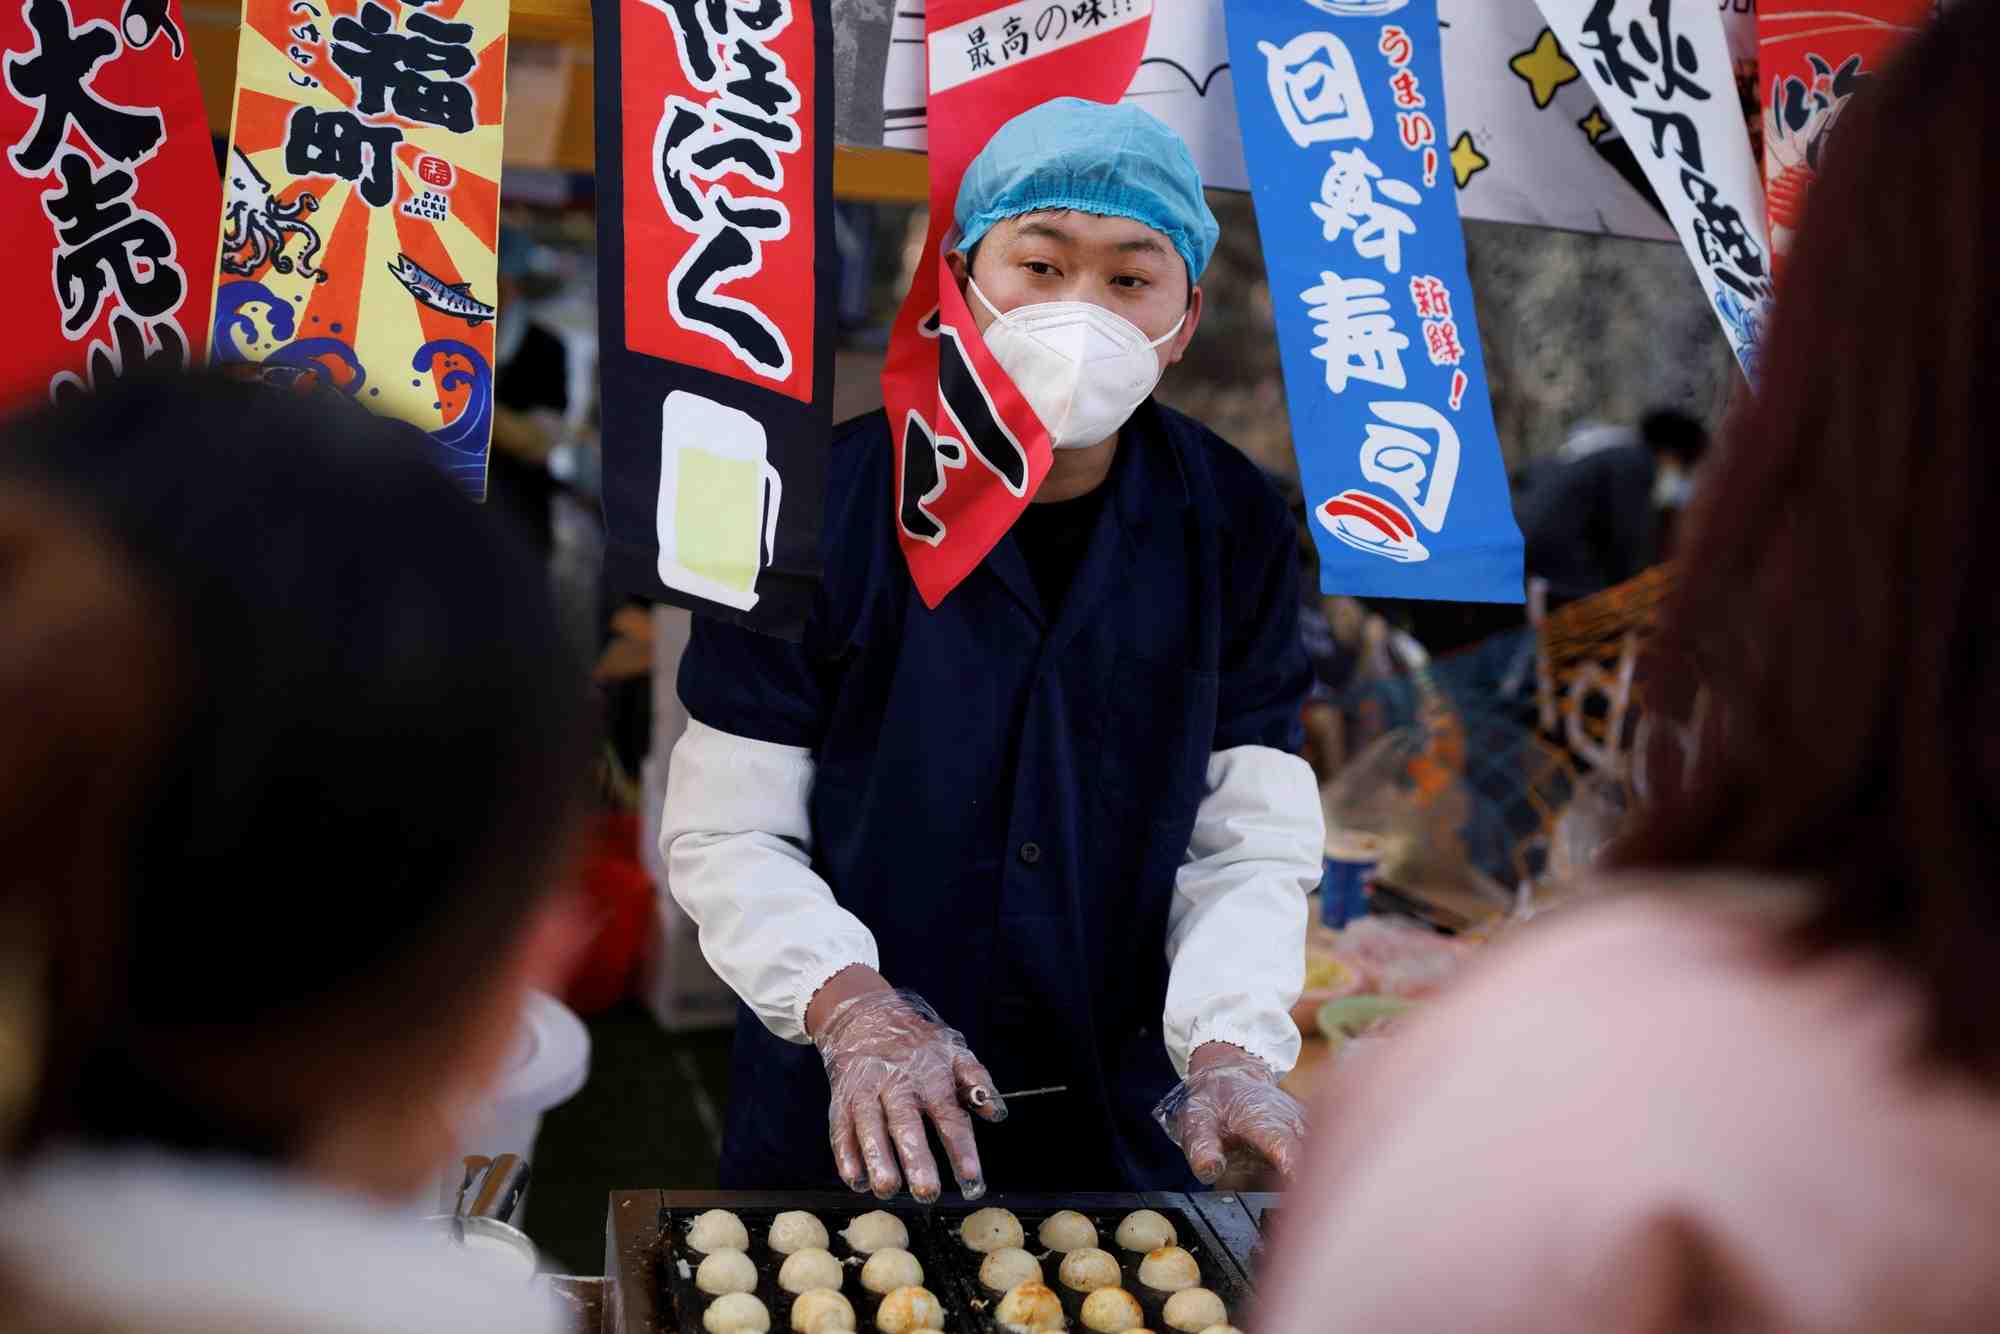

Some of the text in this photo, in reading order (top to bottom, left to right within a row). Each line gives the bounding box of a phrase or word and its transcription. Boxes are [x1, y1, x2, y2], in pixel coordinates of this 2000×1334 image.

[285, 0, 477, 207] 福町
[4, 0, 189, 400] 大売
[414, 198, 446, 212] FUKU
[424, 192, 447, 203] DAI
[403, 204, 446, 221] MACHI
